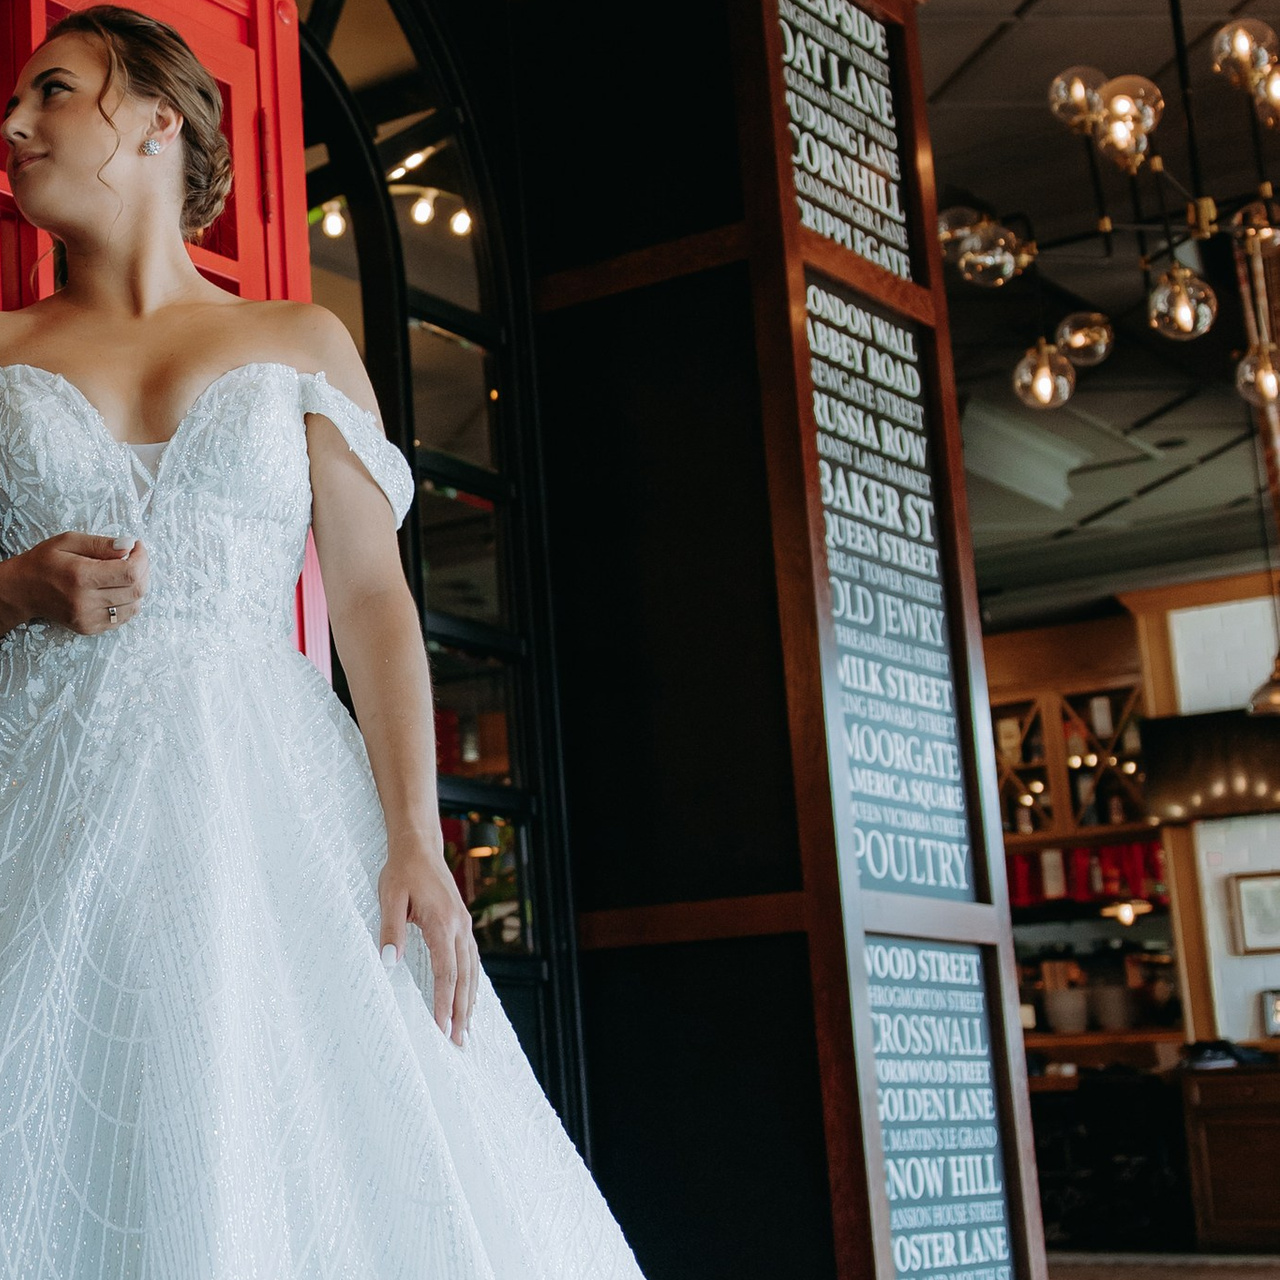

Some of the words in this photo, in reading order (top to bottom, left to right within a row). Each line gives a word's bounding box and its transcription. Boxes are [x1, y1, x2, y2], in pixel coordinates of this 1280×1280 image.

[828, 52, 896, 128] LANE
[857, 133, 901, 181] LANE
[874, 213, 908, 250] LANE
[805, 284, 872, 340] ONDON
[872, 316, 918, 362] WALL
[865, 346, 920, 398] ROAD
[875, 387, 924, 431] STREET
[879, 419, 927, 468] ROW
[853, 446, 885, 479] LANE
[885, 459, 931, 496] MARKET
[903, 493, 934, 543] ST
[879, 531, 939, 578] STREET
[861, 560, 904, 592] TOWER
[903, 573, 943, 605] STREET
[876, 591, 945, 646] JEWRY
[835, 623, 913, 664] HREADNEEDLE
[914, 646, 950, 674] STREET
[885, 666, 952, 713] STREET
[841, 691, 867, 718] ING
[867, 698, 916, 729] EDWARD
[916, 710, 956, 738] STREET
[845, 723, 961, 781] MOORGATE
[910, 779, 964, 812] SQUARE
[882, 805, 931, 832] VICTORIA
[932, 814, 967, 838] STREET
[852, 827, 969, 890] POULTRY
[917, 949, 981, 986] STREET
[867, 985, 947, 1012] HROGMORTON
[948, 989, 985, 1013] STREET
[875, 1059, 947, 1084] ORMWOOD
[947, 1060, 991, 1084] STREET
[946, 1088, 995, 1121] LANE
[958, 1126, 998, 1150] GRAND
[884, 1156, 945, 1200] NOW
[948, 1154, 1002, 1197] HILL
[932, 1203, 968, 1227] HOUSE
[967, 1200, 1004, 1223] STREET
[891, 1231, 958, 1272] OSTER
[958, 1226, 1009, 1265] LANE
